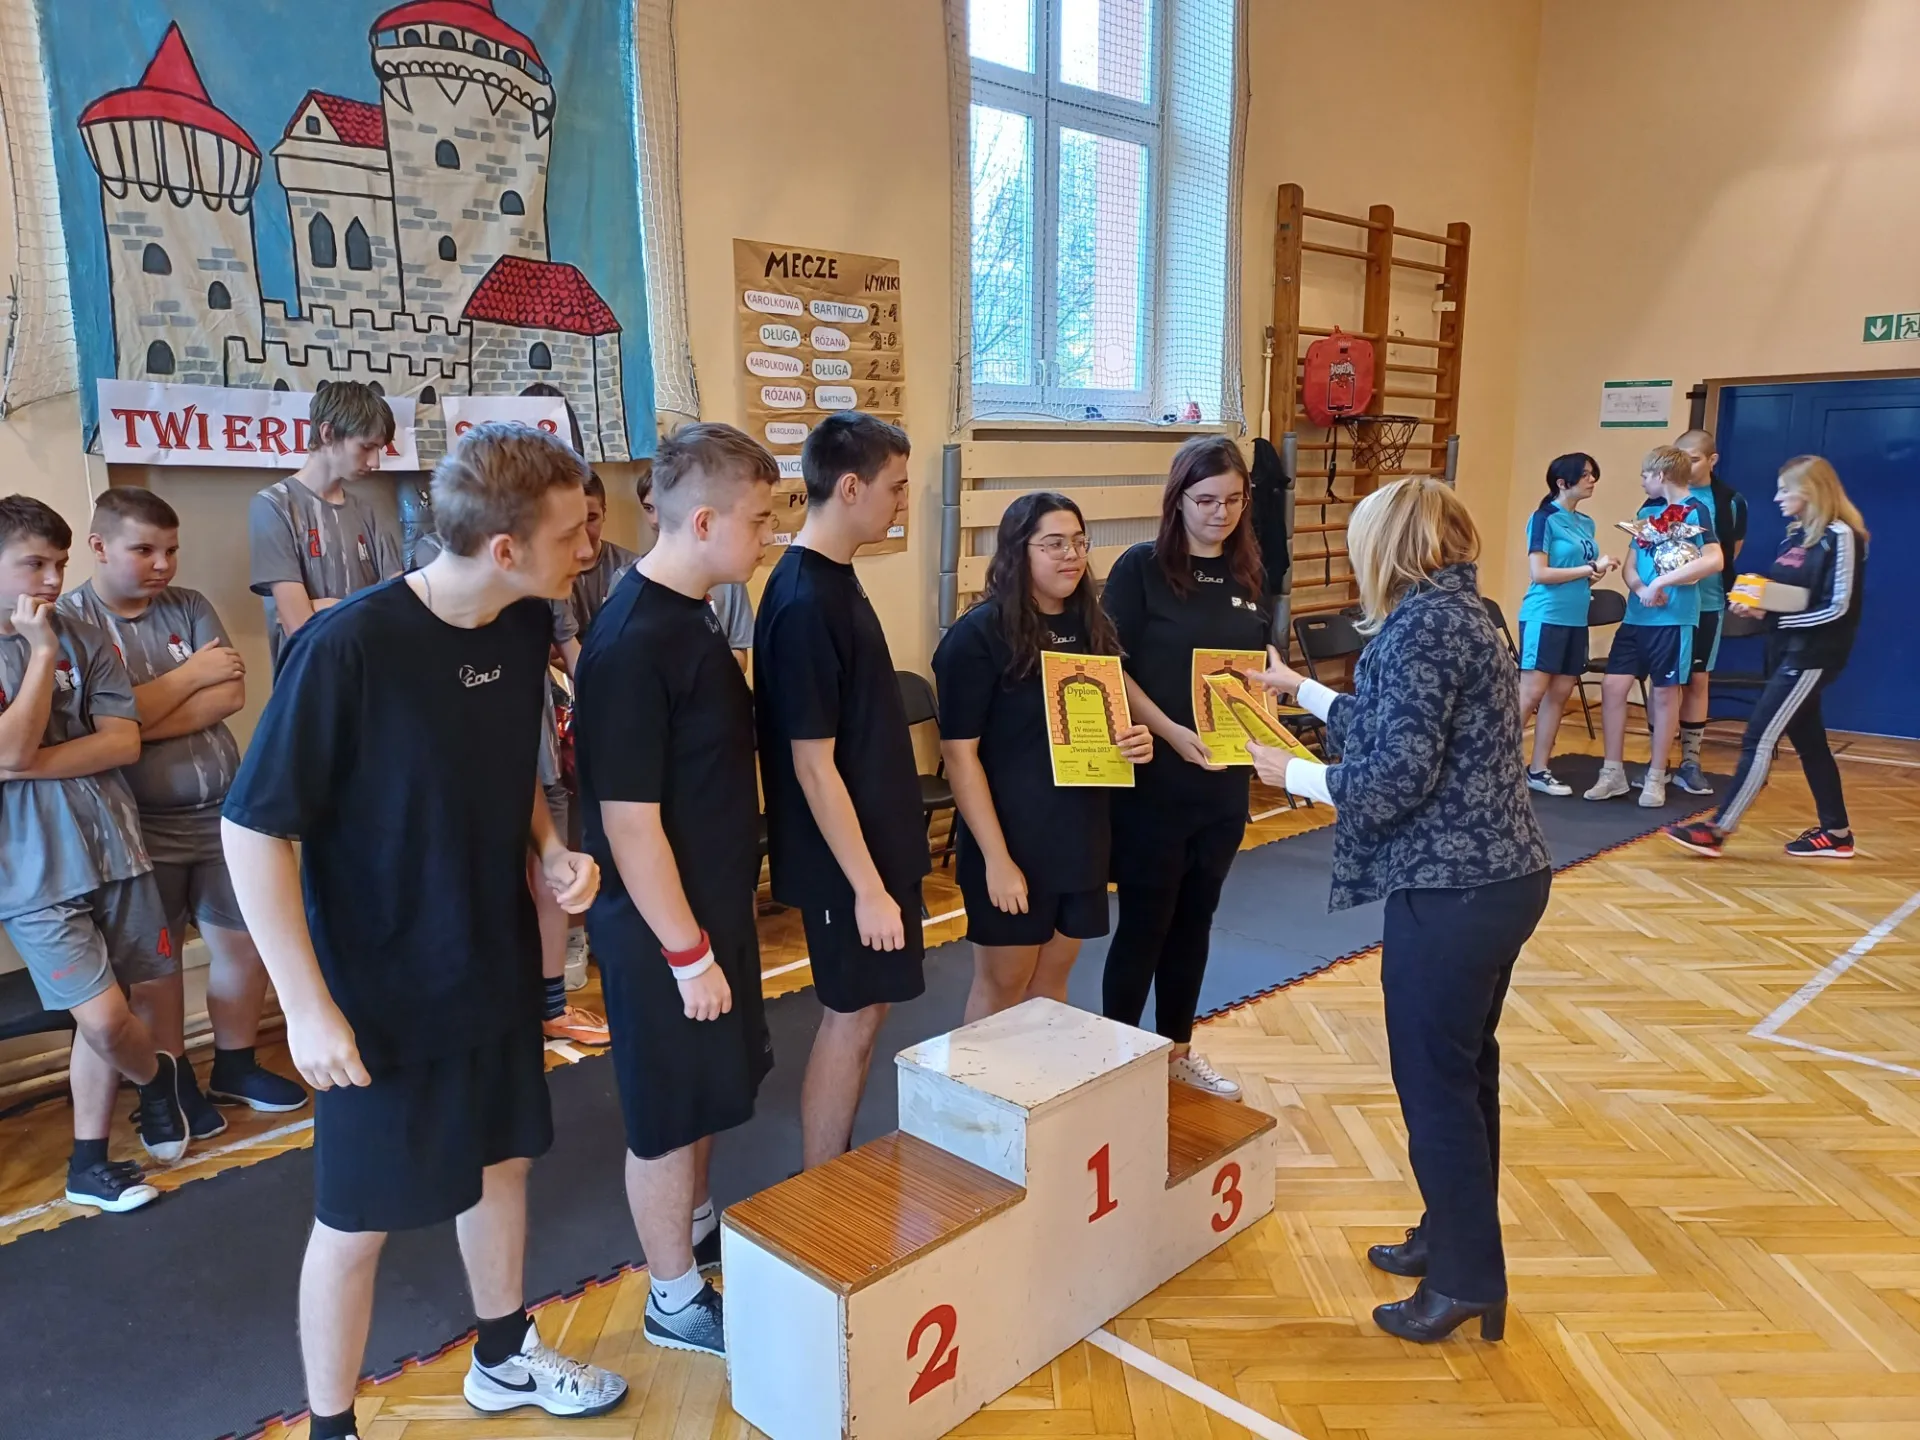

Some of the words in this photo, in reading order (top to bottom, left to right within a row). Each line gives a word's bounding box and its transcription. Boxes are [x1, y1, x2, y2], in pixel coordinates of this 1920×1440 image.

[764, 251, 838, 279] MECZE
[865, 273, 900, 292] WYNIKI
[747, 293, 800, 311] KAROLKOWA
[814, 303, 864, 319] BARTNICZA
[763, 327, 798, 342] DŁUGA
[815, 335, 846, 348] RÓŻANA
[750, 357, 799, 373] KAROLKOWA
[815, 363, 849, 376] DŁUGA
[764, 388, 802, 402] RÓŻANA
[820, 395, 852, 404] BARTNICZA
[770, 427, 803, 435] KAROLKOWA
[789, 494, 808, 508] PU
[1580, 539, 1594, 561] 13
[1066, 686, 1099, 698] Dyplom
[157, 927, 171, 958] 4
[1087, 1143, 1118, 1223] 1
[1211, 1162, 1243, 1232] 3
[907, 1304, 959, 1403] 2
